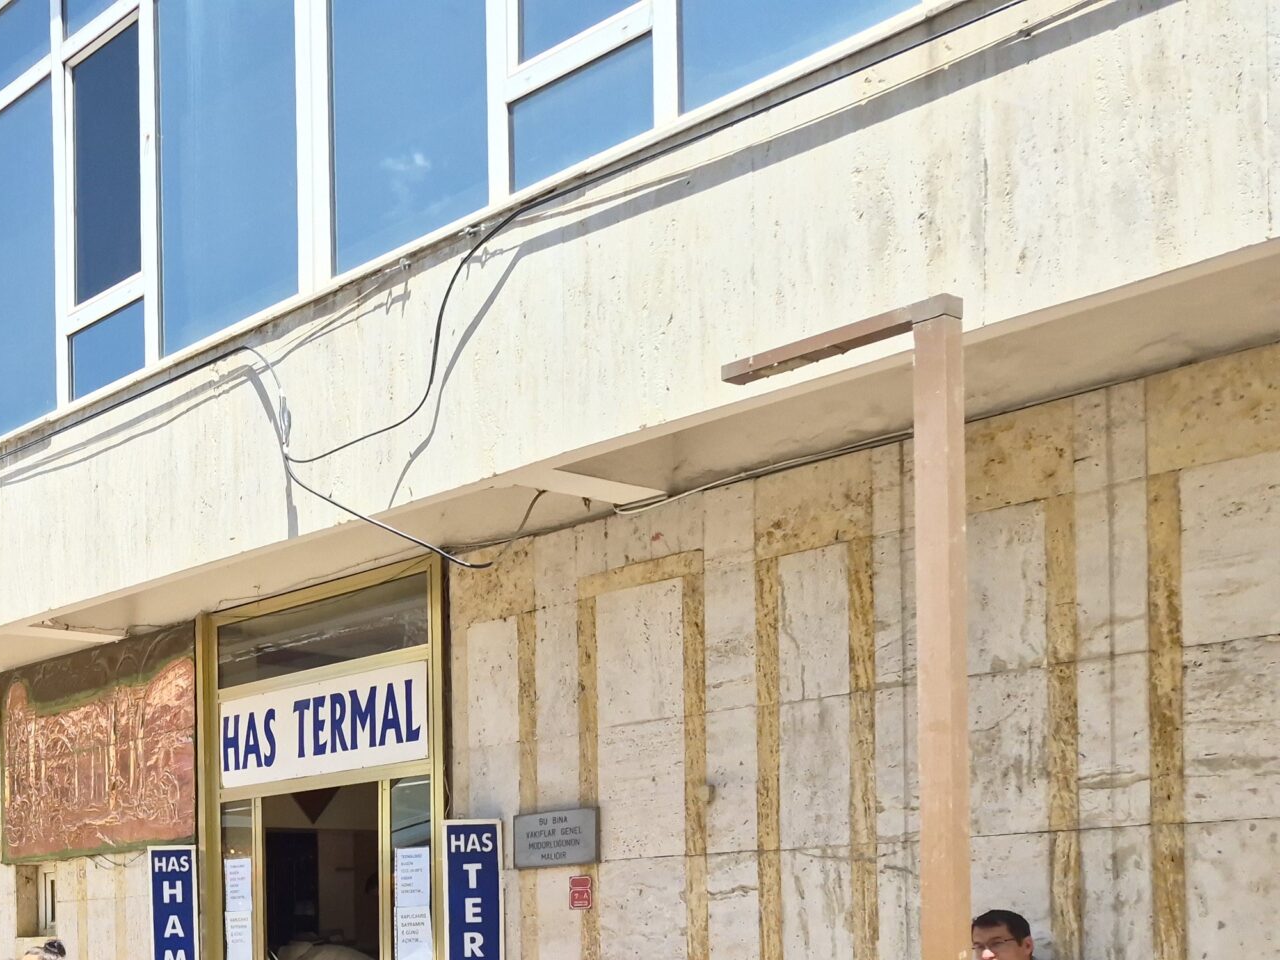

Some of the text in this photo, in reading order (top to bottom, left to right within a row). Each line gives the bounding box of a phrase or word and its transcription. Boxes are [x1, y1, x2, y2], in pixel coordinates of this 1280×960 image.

[223, 679, 421, 772] HAS TERMAL
[526, 826, 582, 839] VAKIFLAR GENEL
[450, 832, 493, 853] HAS
[154, 855, 190, 873] HAS
